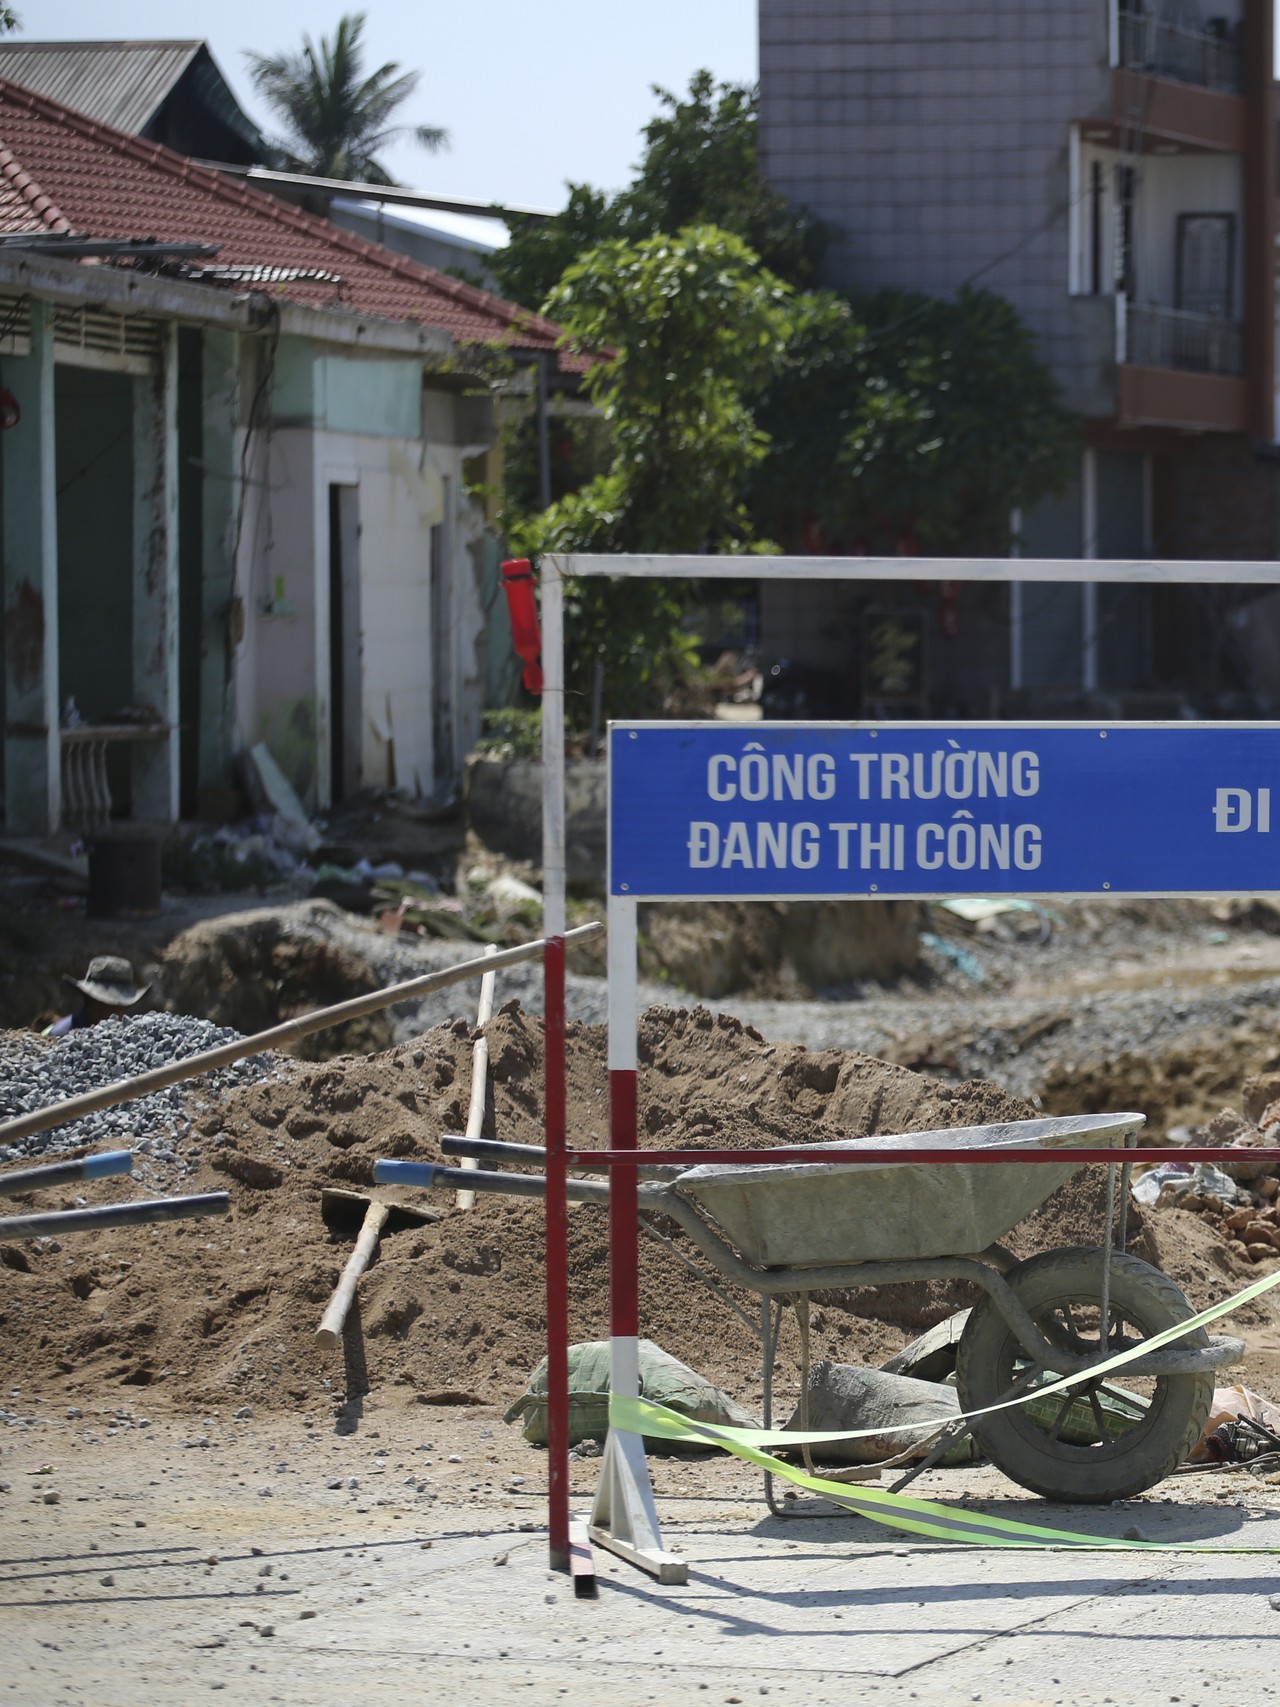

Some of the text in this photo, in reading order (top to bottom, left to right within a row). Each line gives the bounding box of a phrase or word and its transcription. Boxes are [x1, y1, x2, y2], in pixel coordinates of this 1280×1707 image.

[707, 739, 1039, 801] CÔNG TRƯỜNG
[1212, 788, 1270, 832] ĐI
[687, 811, 1042, 871] ĐANG THI CÔNG
